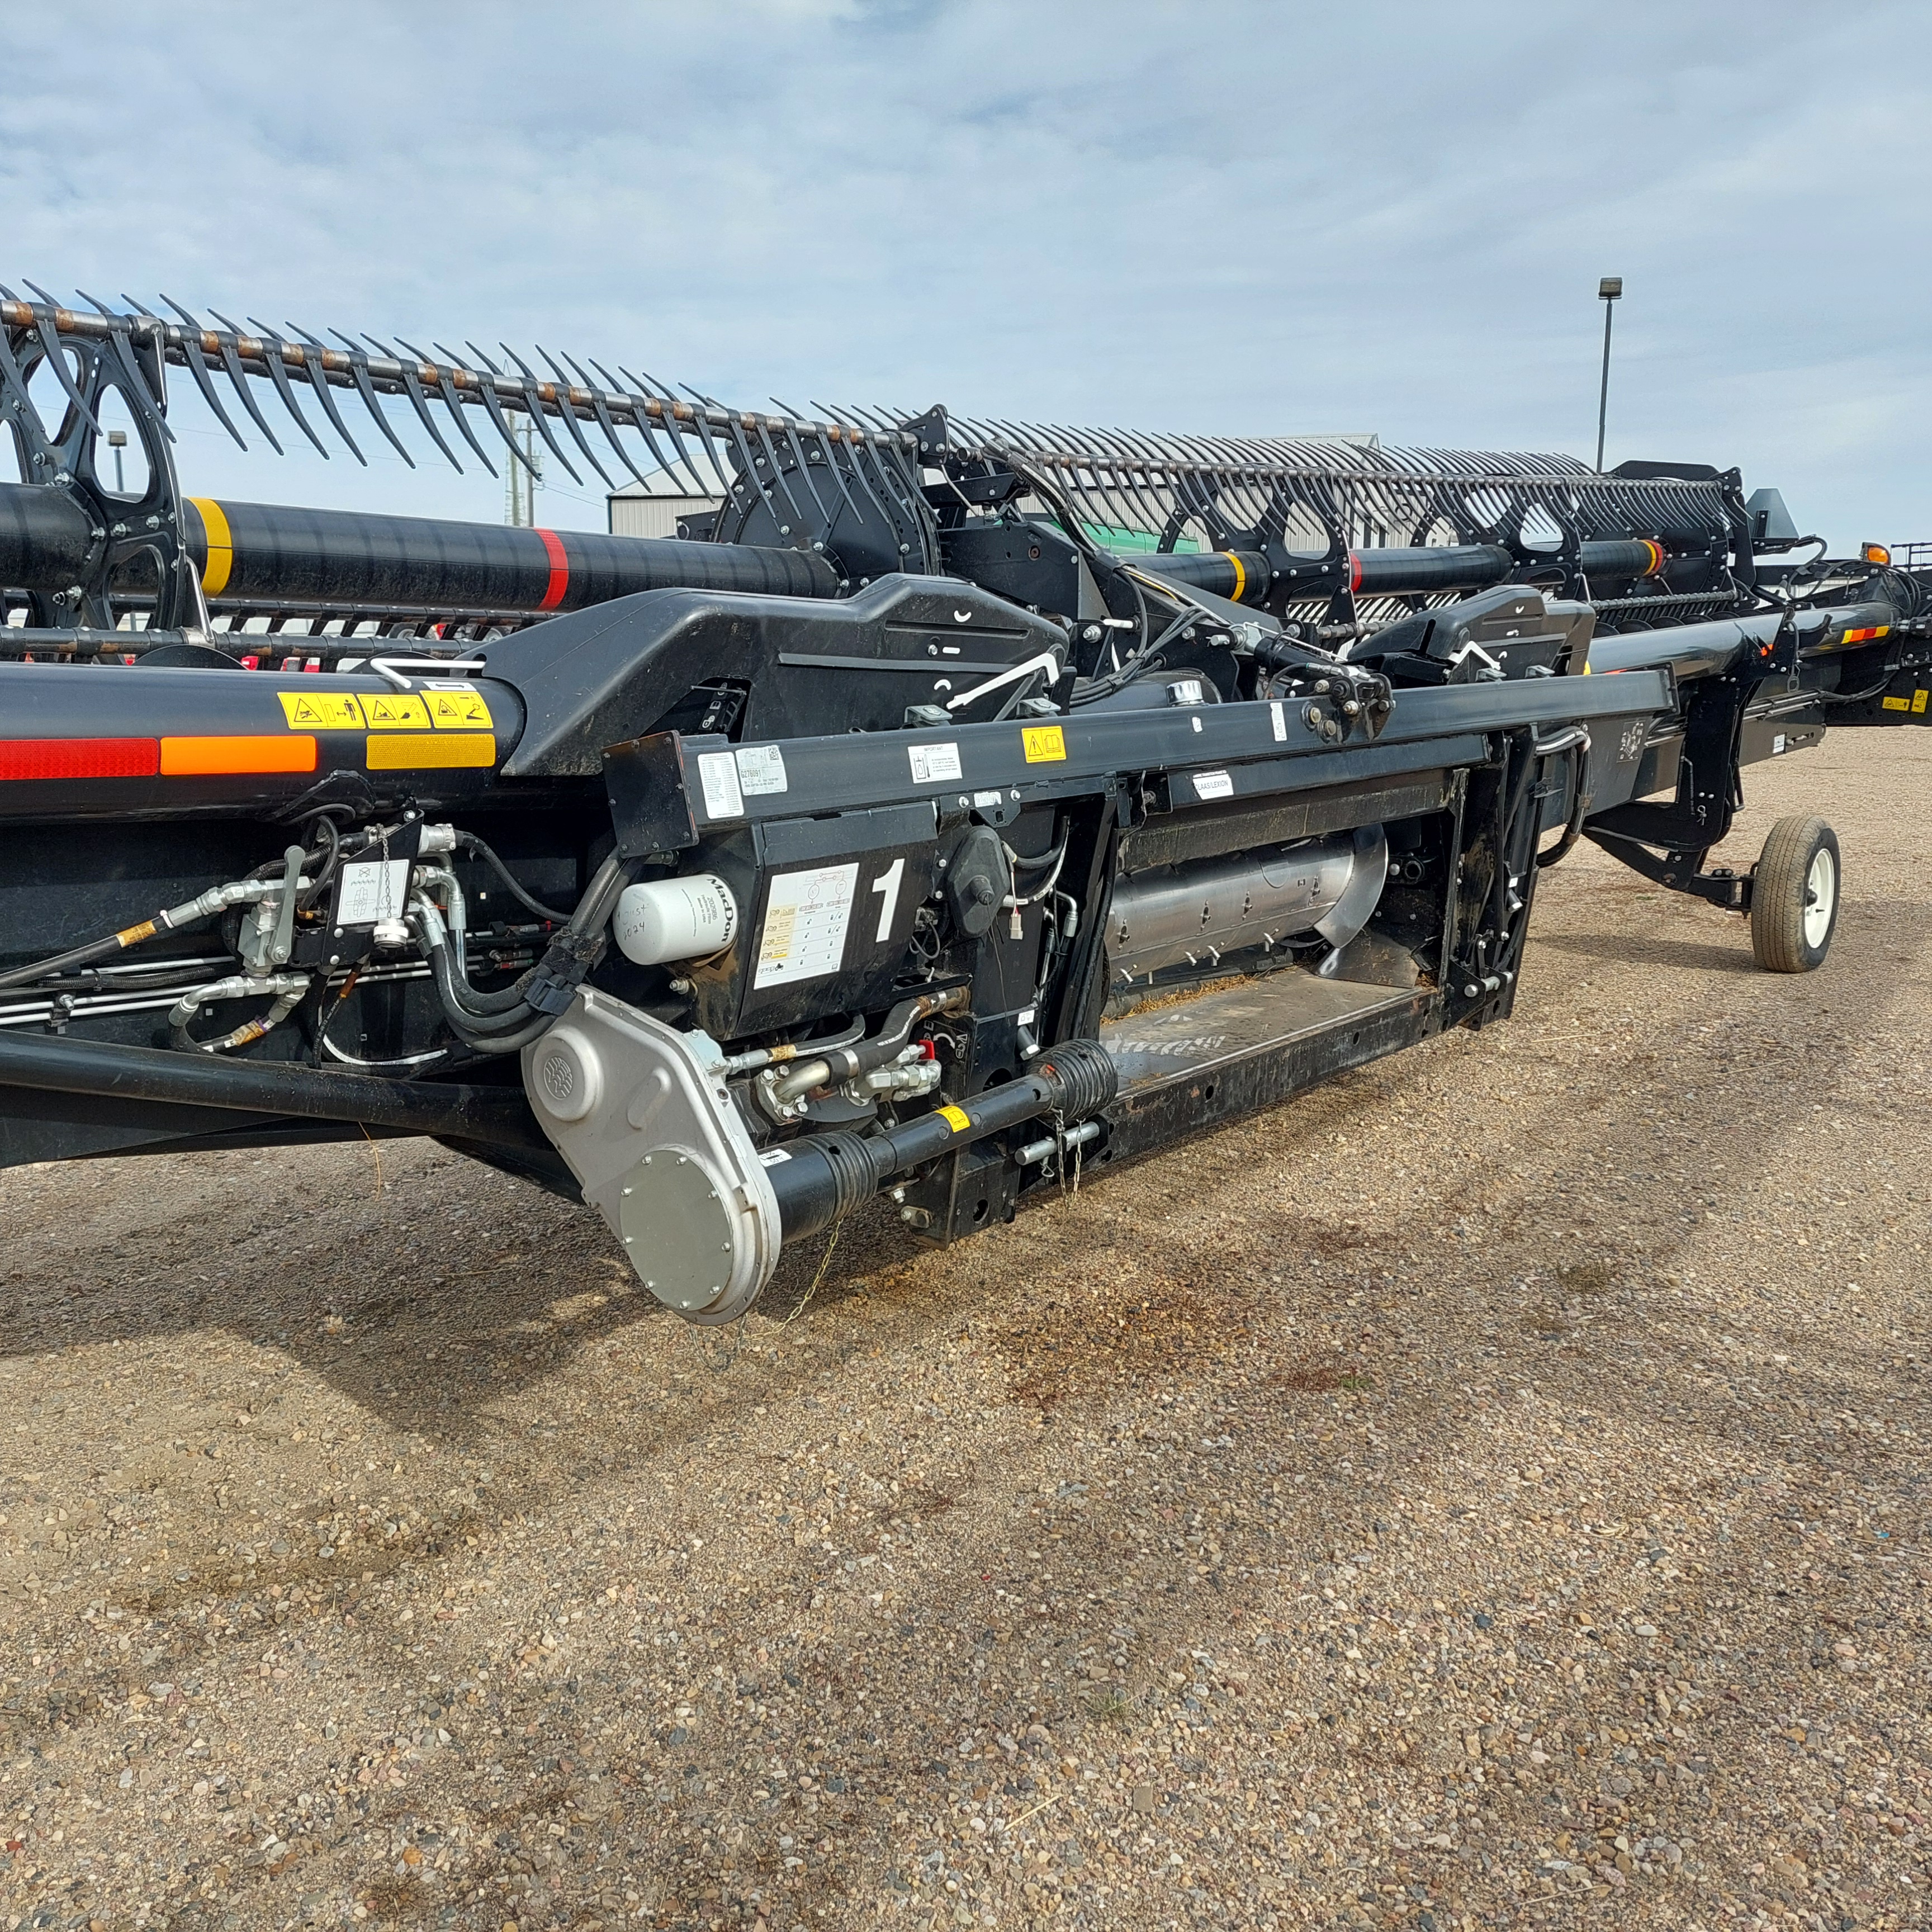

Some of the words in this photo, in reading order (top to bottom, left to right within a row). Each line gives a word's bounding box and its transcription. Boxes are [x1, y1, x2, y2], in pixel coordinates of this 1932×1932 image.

[740, 769, 761, 778] G276091
[706, 878, 733, 942] MacDon
[707, 896, 718, 920] 202986
[872, 858, 905, 943] 1
[623, 921, 645, 941] 2024
